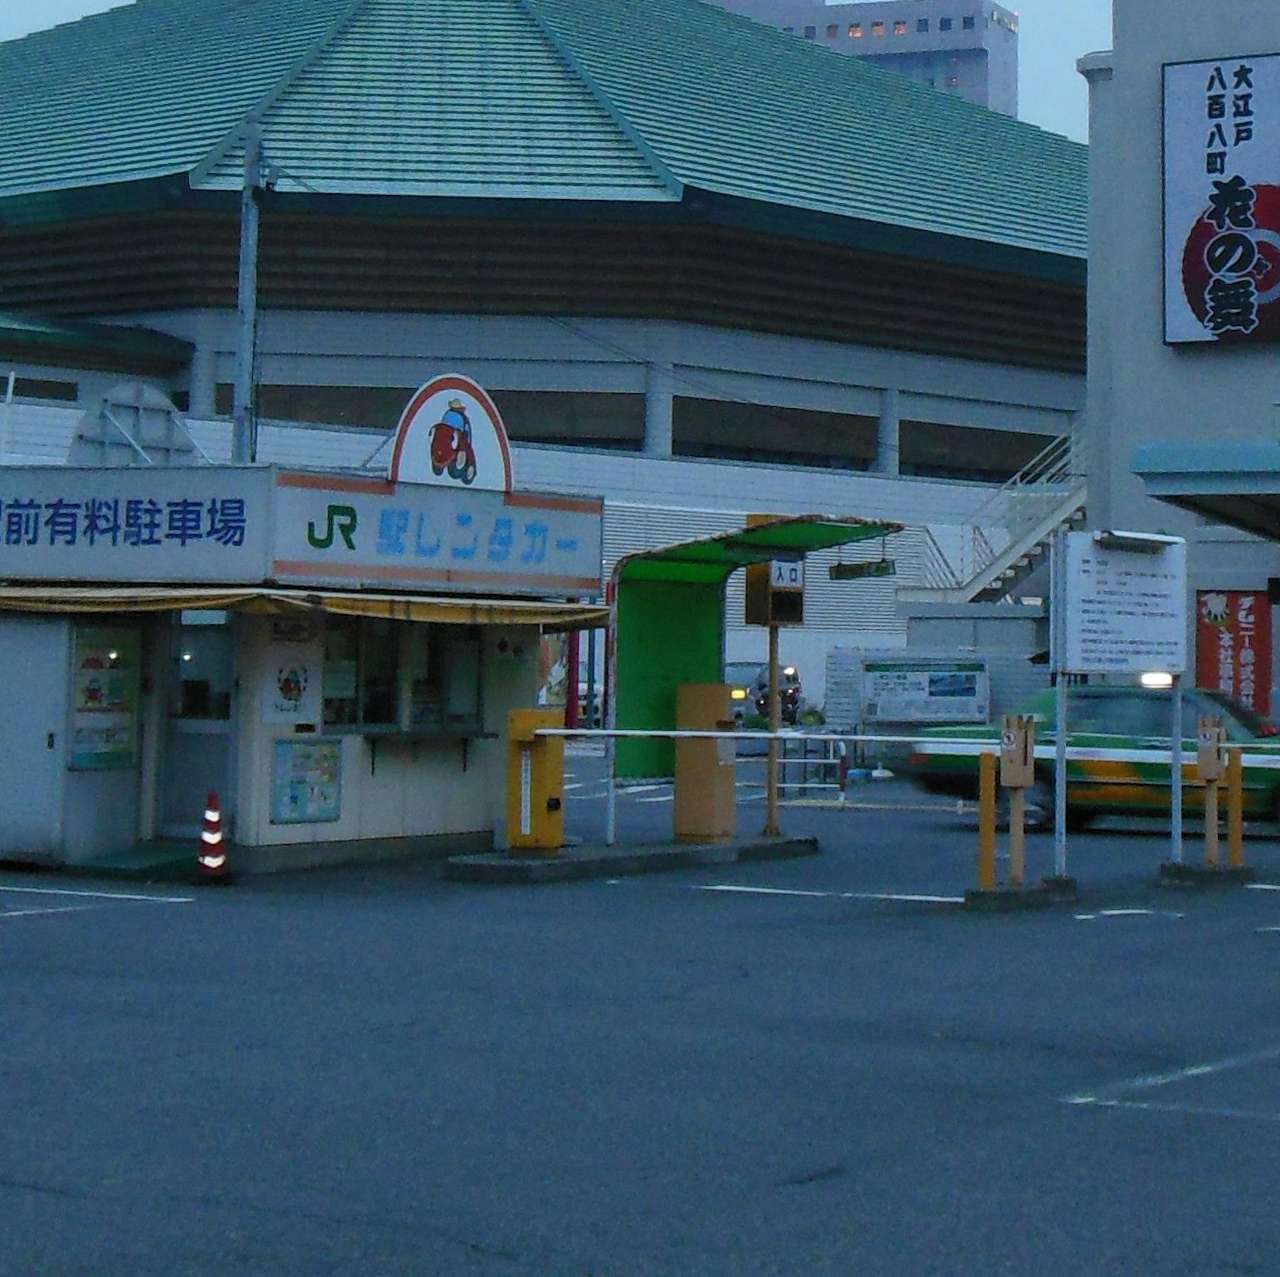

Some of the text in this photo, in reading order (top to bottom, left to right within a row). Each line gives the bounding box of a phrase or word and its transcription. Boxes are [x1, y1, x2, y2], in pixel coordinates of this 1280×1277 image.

[1205, 65, 1228, 175] 八百八町
[1232, 64, 1254, 147] 大江戸
[1204, 174, 1259, 334] 花の舞
[307, 504, 578, 564] JR 駅レンタカー
[776, 566, 798, 583] 入口
